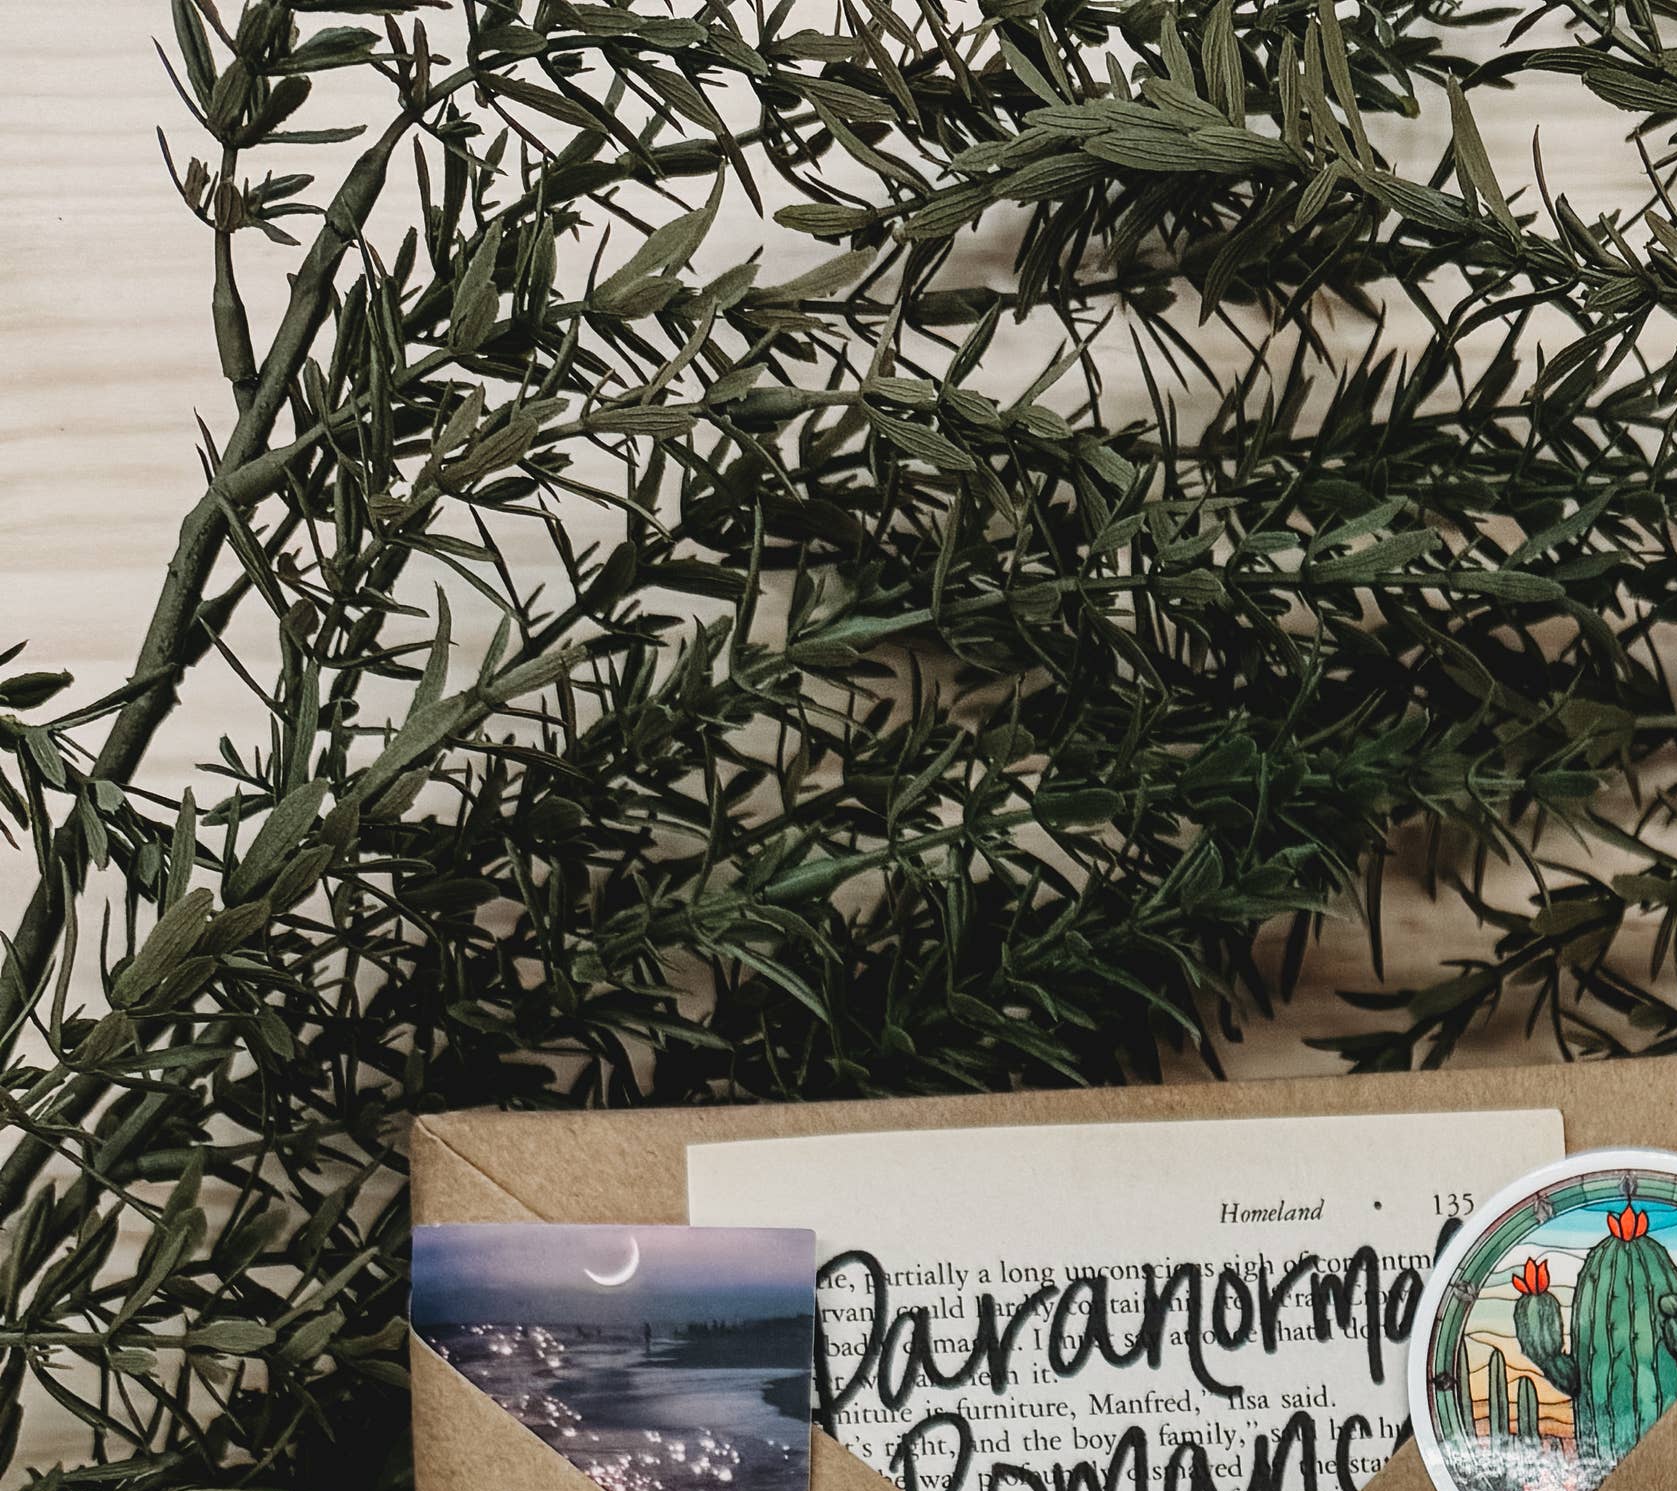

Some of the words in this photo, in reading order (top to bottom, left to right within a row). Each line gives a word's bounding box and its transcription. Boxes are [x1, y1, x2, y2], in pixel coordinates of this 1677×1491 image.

[1220, 1198, 1326, 1224] Homeland
[1433, 1192, 1475, 1218] 135
[978, 1268, 992, 1284] a
[1001, 1260, 1055, 1288] long
[812, 1216, 1462, 1442] Paranorma
[1033, 1363, 1058, 1385] it.
[957, 1397, 1076, 1420] furniture,
[1281, 1384, 1336, 1408] said.
[1023, 1428, 1062, 1451] the
